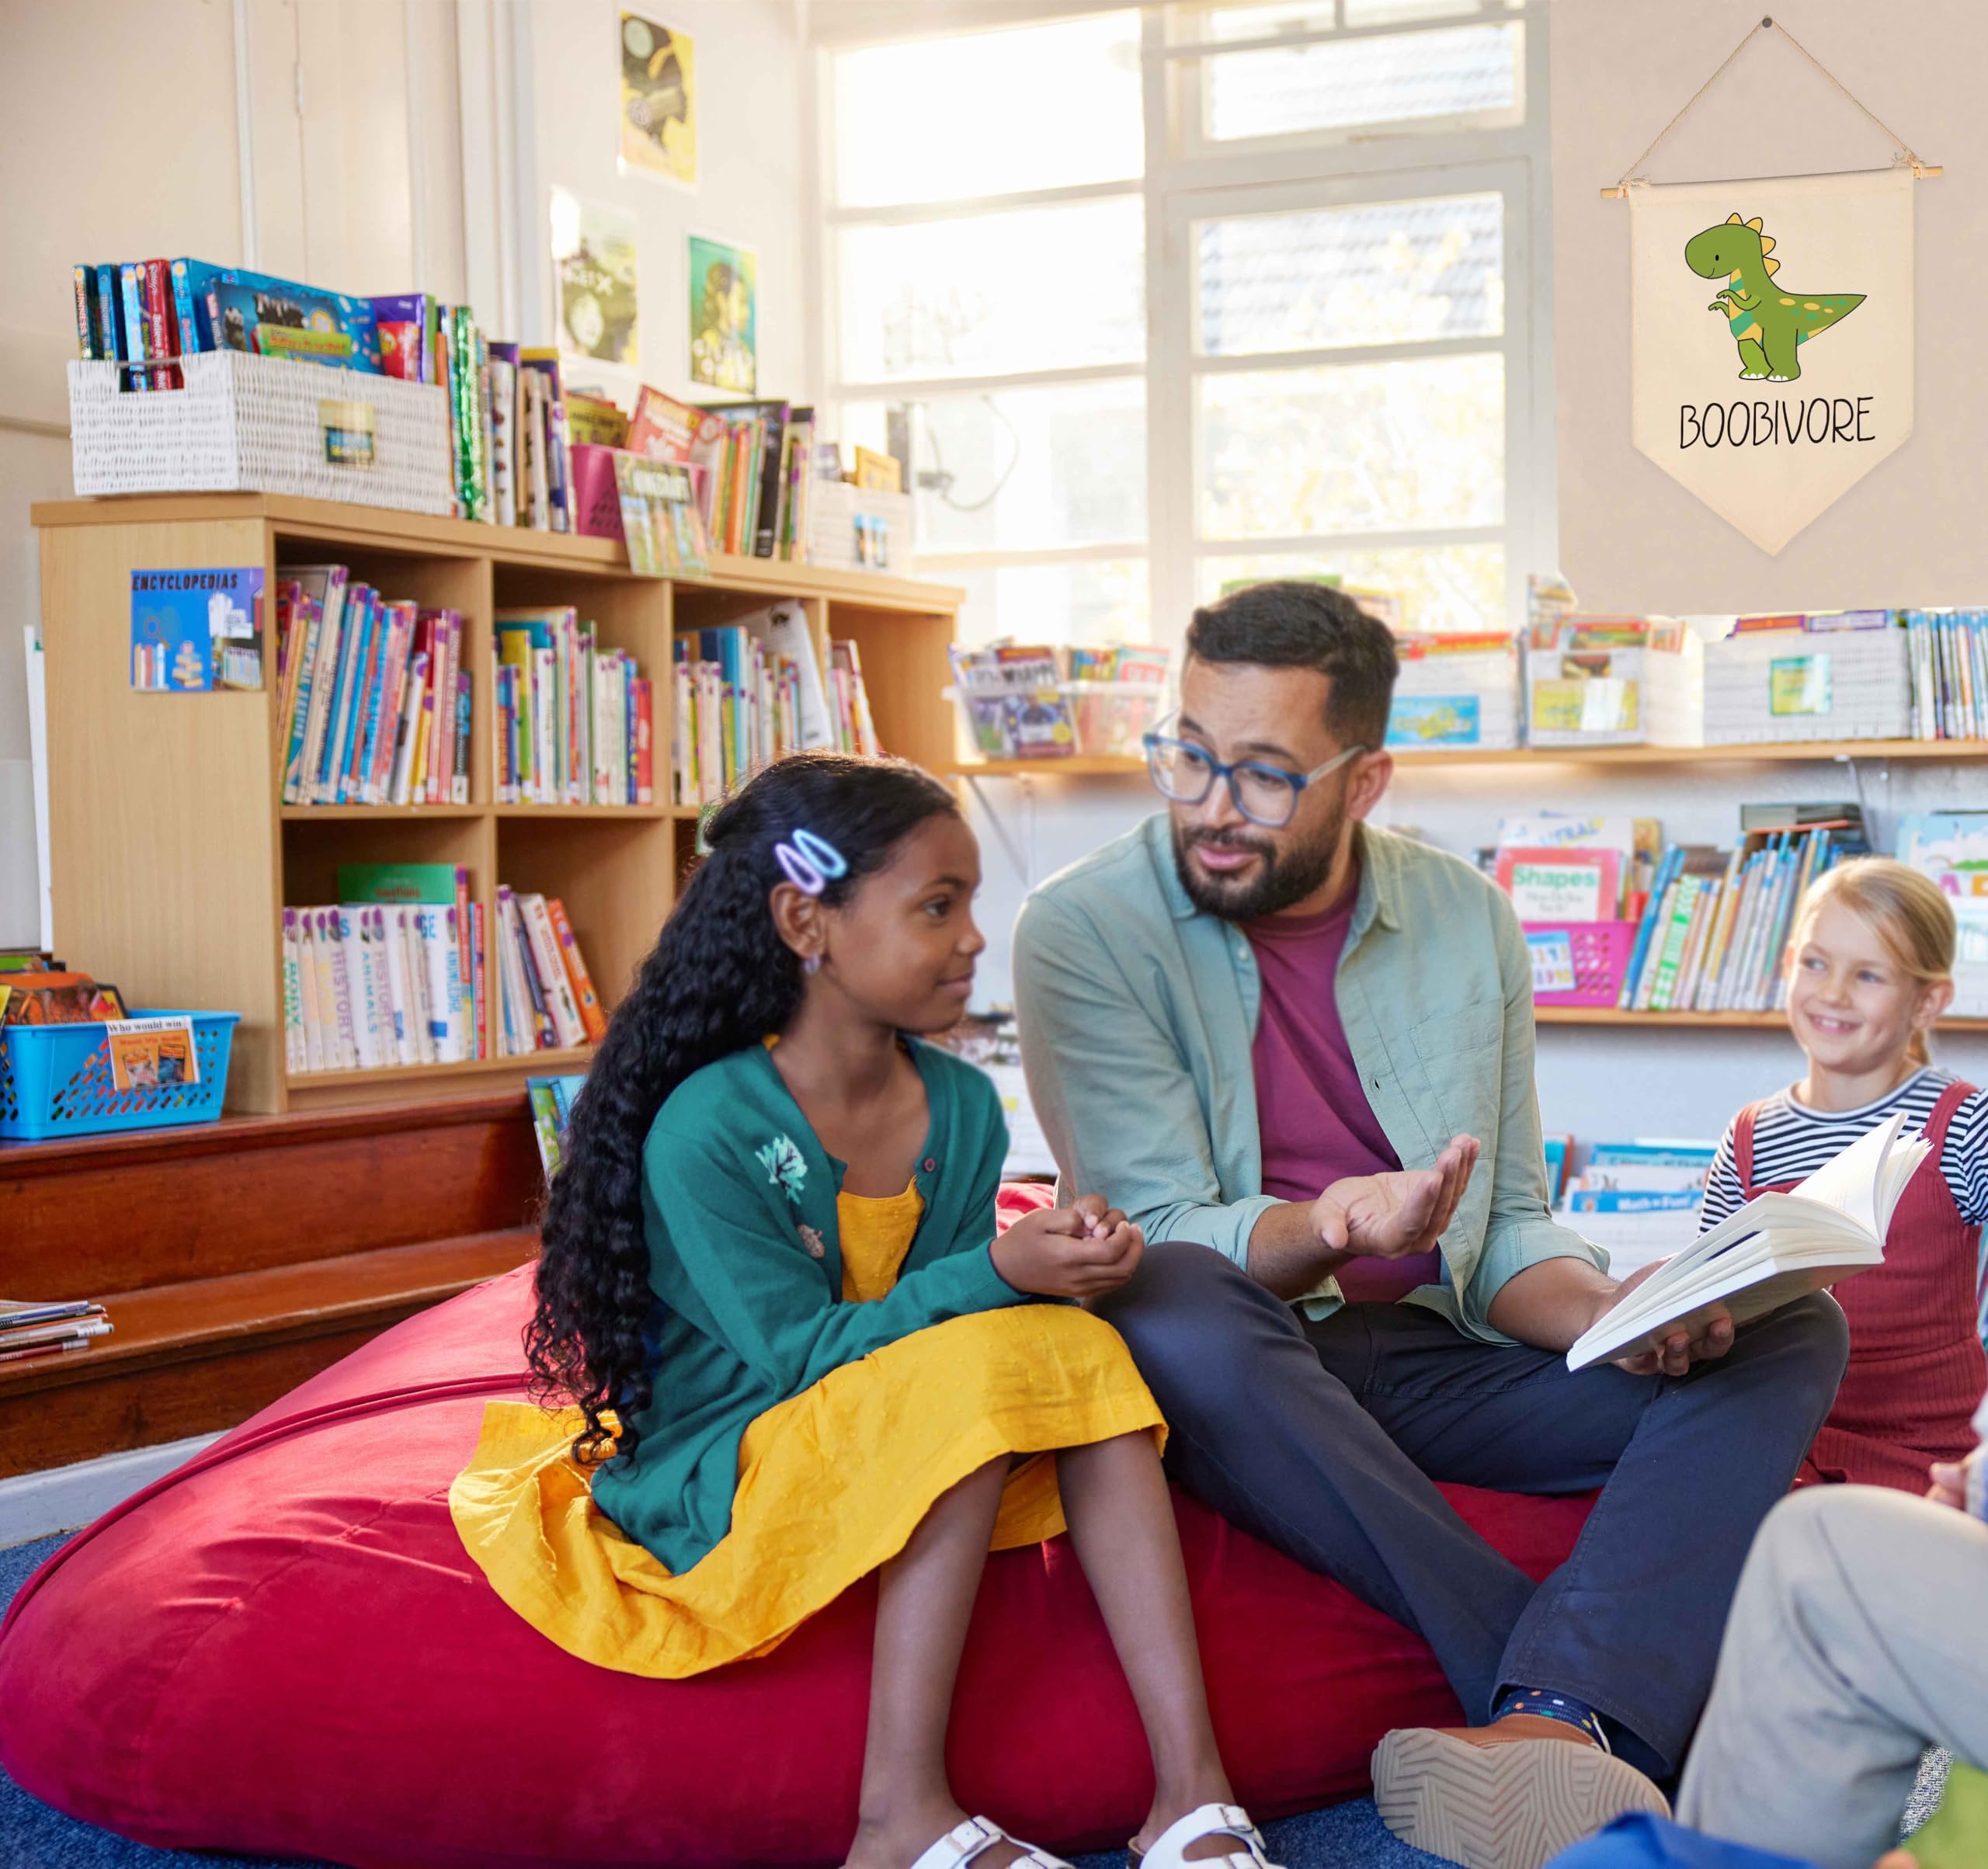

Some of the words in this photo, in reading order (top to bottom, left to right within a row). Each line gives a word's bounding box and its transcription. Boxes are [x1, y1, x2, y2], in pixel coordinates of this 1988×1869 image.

[1680, 396, 1875, 449] BOOBIVORE
[132, 573, 238, 591] ENCYCLOPEDIAS
[1514, 866, 1597, 890] Shapes
[332, 950, 352, 1040] HISTORY
[362, 951, 378, 1034] ANIMALS
[374, 950, 391, 1029] HISTORY
[109, 1023, 131, 1032] Who
[134, 1021, 162, 1030] would
